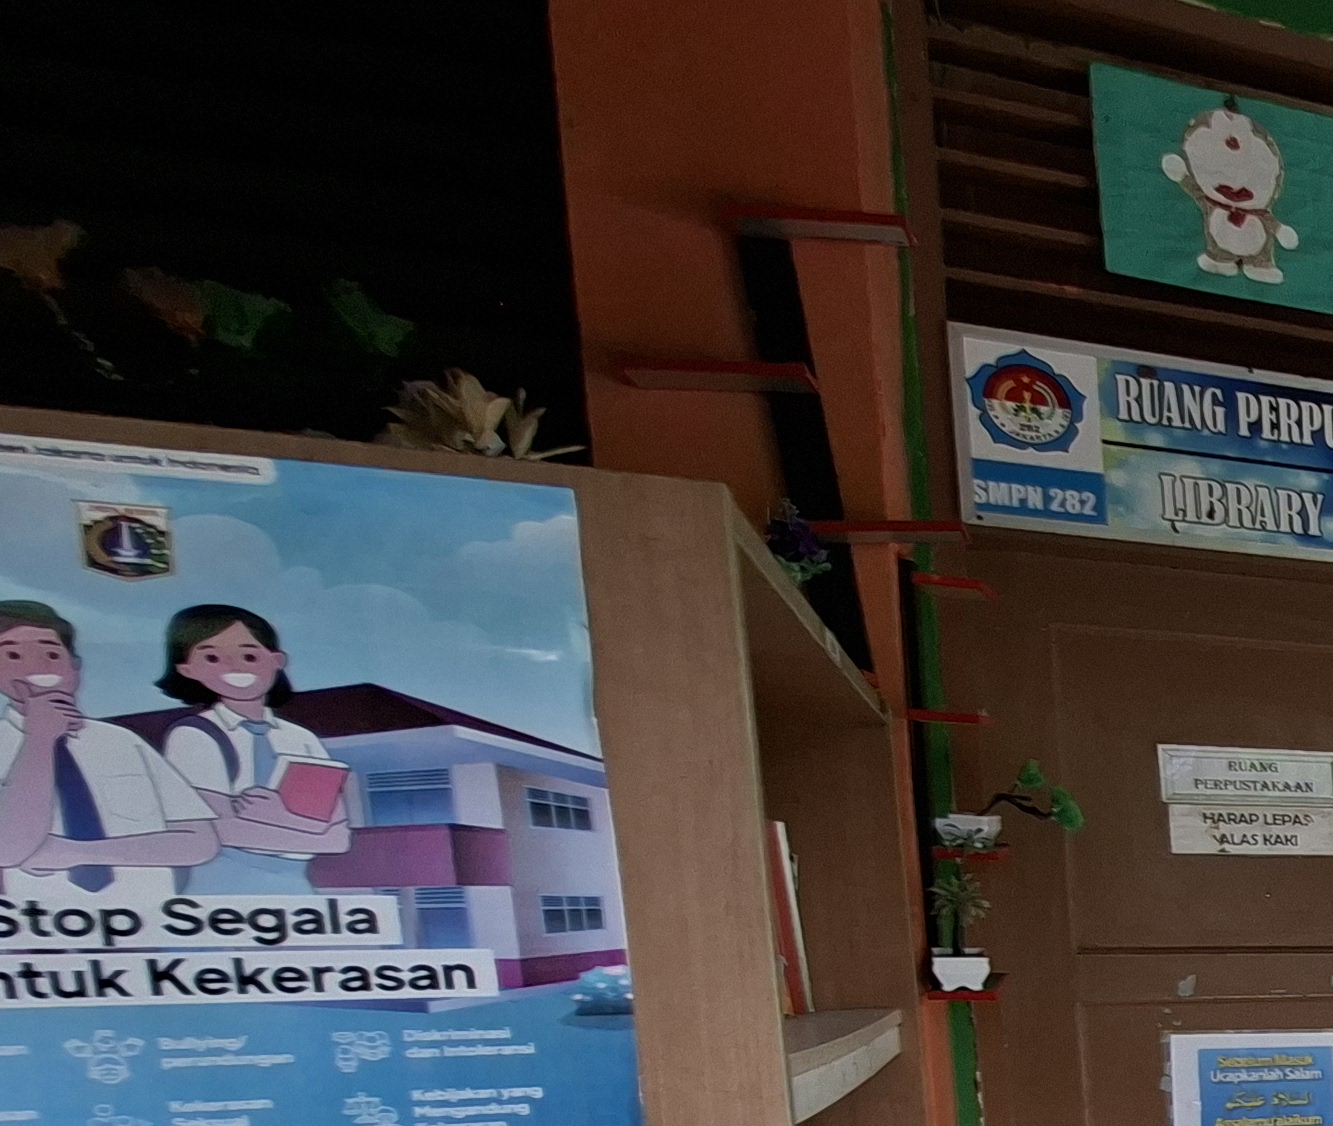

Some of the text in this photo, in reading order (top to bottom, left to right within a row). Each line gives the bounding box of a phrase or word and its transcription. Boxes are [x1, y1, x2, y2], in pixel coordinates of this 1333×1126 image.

[1114, 373, 1227, 435] RUANG
[973, 478, 1098, 516] SMPN 282
[1160, 473, 1325, 538] LIBRARY
[1194, 778, 1314, 793] PERPUSTAKAAN
[1228, 761, 1279, 773] RUANG
[1203, 812, 1260, 825] HARAP
[1263, 834, 1298, 846] KAKI
[161, 898, 380, 945] Segala
[0, 957, 478, 999] ntuk Kekerasan
